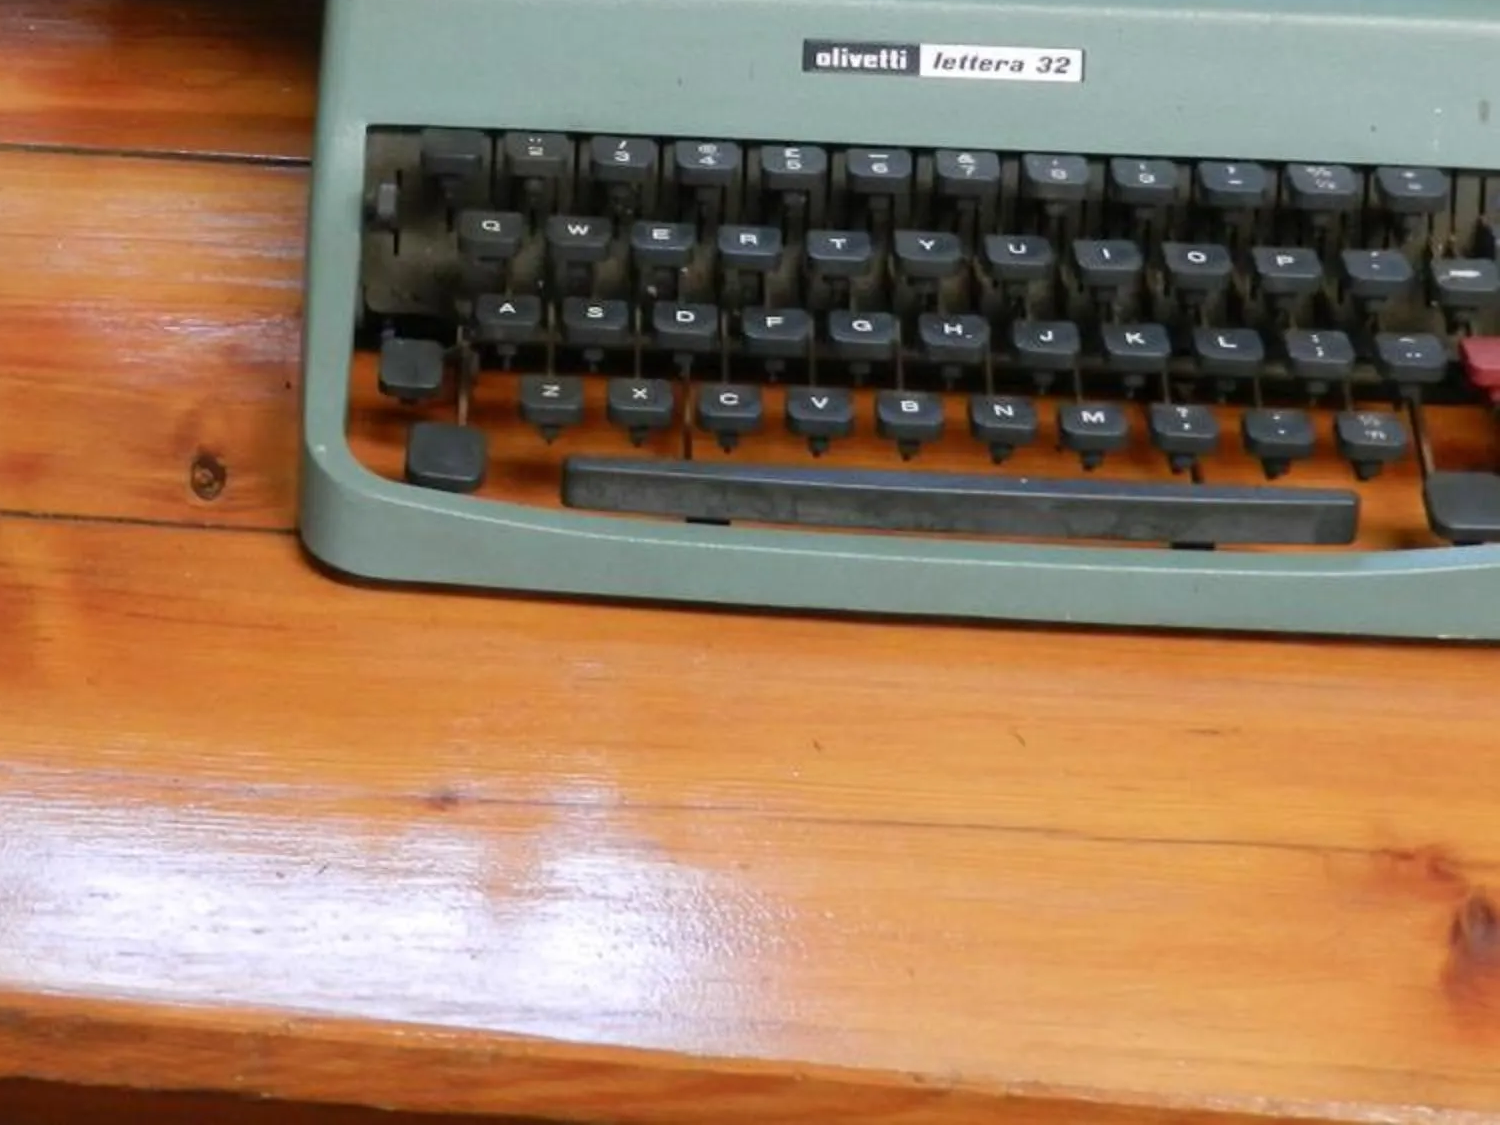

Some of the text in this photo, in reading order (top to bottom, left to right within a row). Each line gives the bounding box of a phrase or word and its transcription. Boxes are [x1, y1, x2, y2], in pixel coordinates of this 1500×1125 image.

[815, 48, 1072, 75] olivetti lettera 32
[698, 156, 716, 165] 4
[872, 163, 888, 173] 6
[482, 220, 501, 232] Q
[567, 224, 589, 235] W
[653, 229, 669, 239] E
[829, 239, 846, 249] T
[918, 240, 936, 251] Y
[1009, 244, 1027, 254] U
[1187, 251, 1206, 263] O
[1277, 256, 1294, 266] P
[499, 303, 1236, 347] A S D F G H J K L
[542, 386, 559, 397] Z
[632, 388, 648, 399] X
[719, 393, 738, 404] C
[810, 397, 829, 408] V
[901, 401, 919, 412] B
[994, 405, 1013, 417] N
[1082, 411, 1105, 423] M
